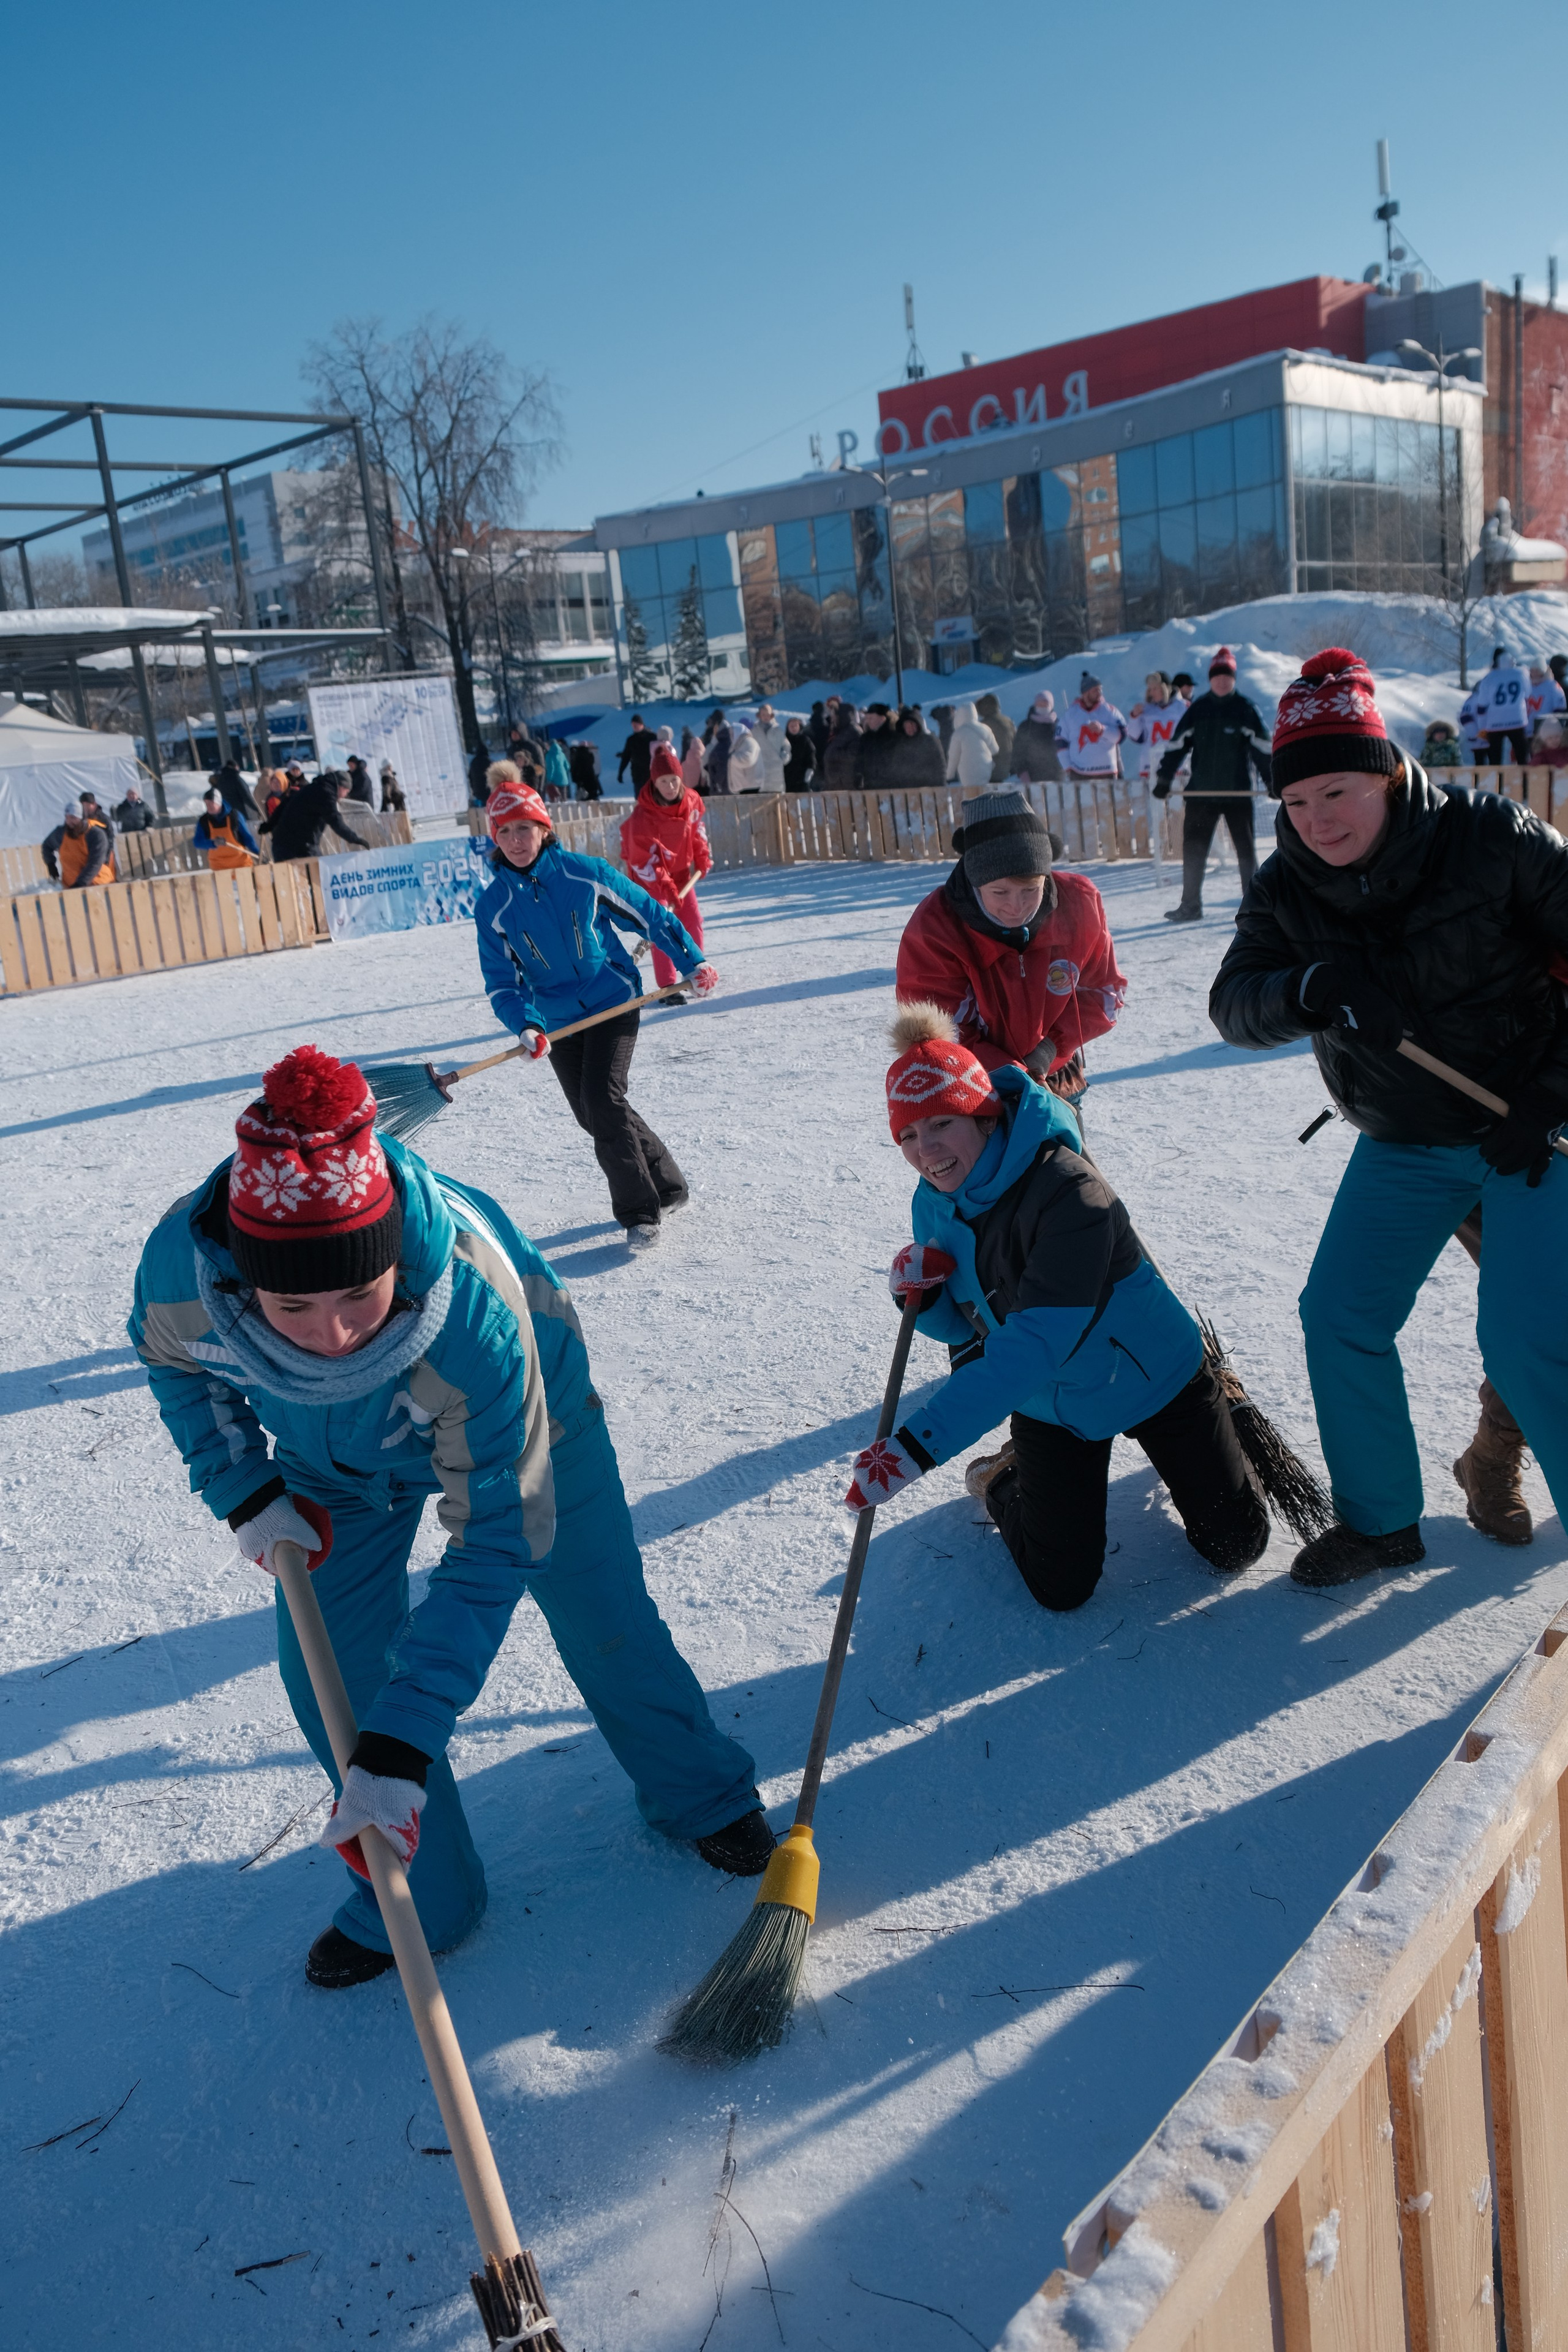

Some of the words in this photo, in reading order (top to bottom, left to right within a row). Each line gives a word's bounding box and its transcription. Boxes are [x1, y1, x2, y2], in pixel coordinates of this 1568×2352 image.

[837, 370, 1088, 467] РОССИЯ
[415, 685, 428, 699] 10
[1495, 681, 1521, 705] 69
[1152, 721, 1174, 745] N
[475, 835, 486, 845] 10
[330, 870, 363, 887] ДЕНЬ
[366, 863, 414, 880] ЗИМНИХ
[422, 854, 484, 886] 2024
[332, 884, 374, 900] ВИДОВ
[377, 877, 421, 893] СПОРТА
